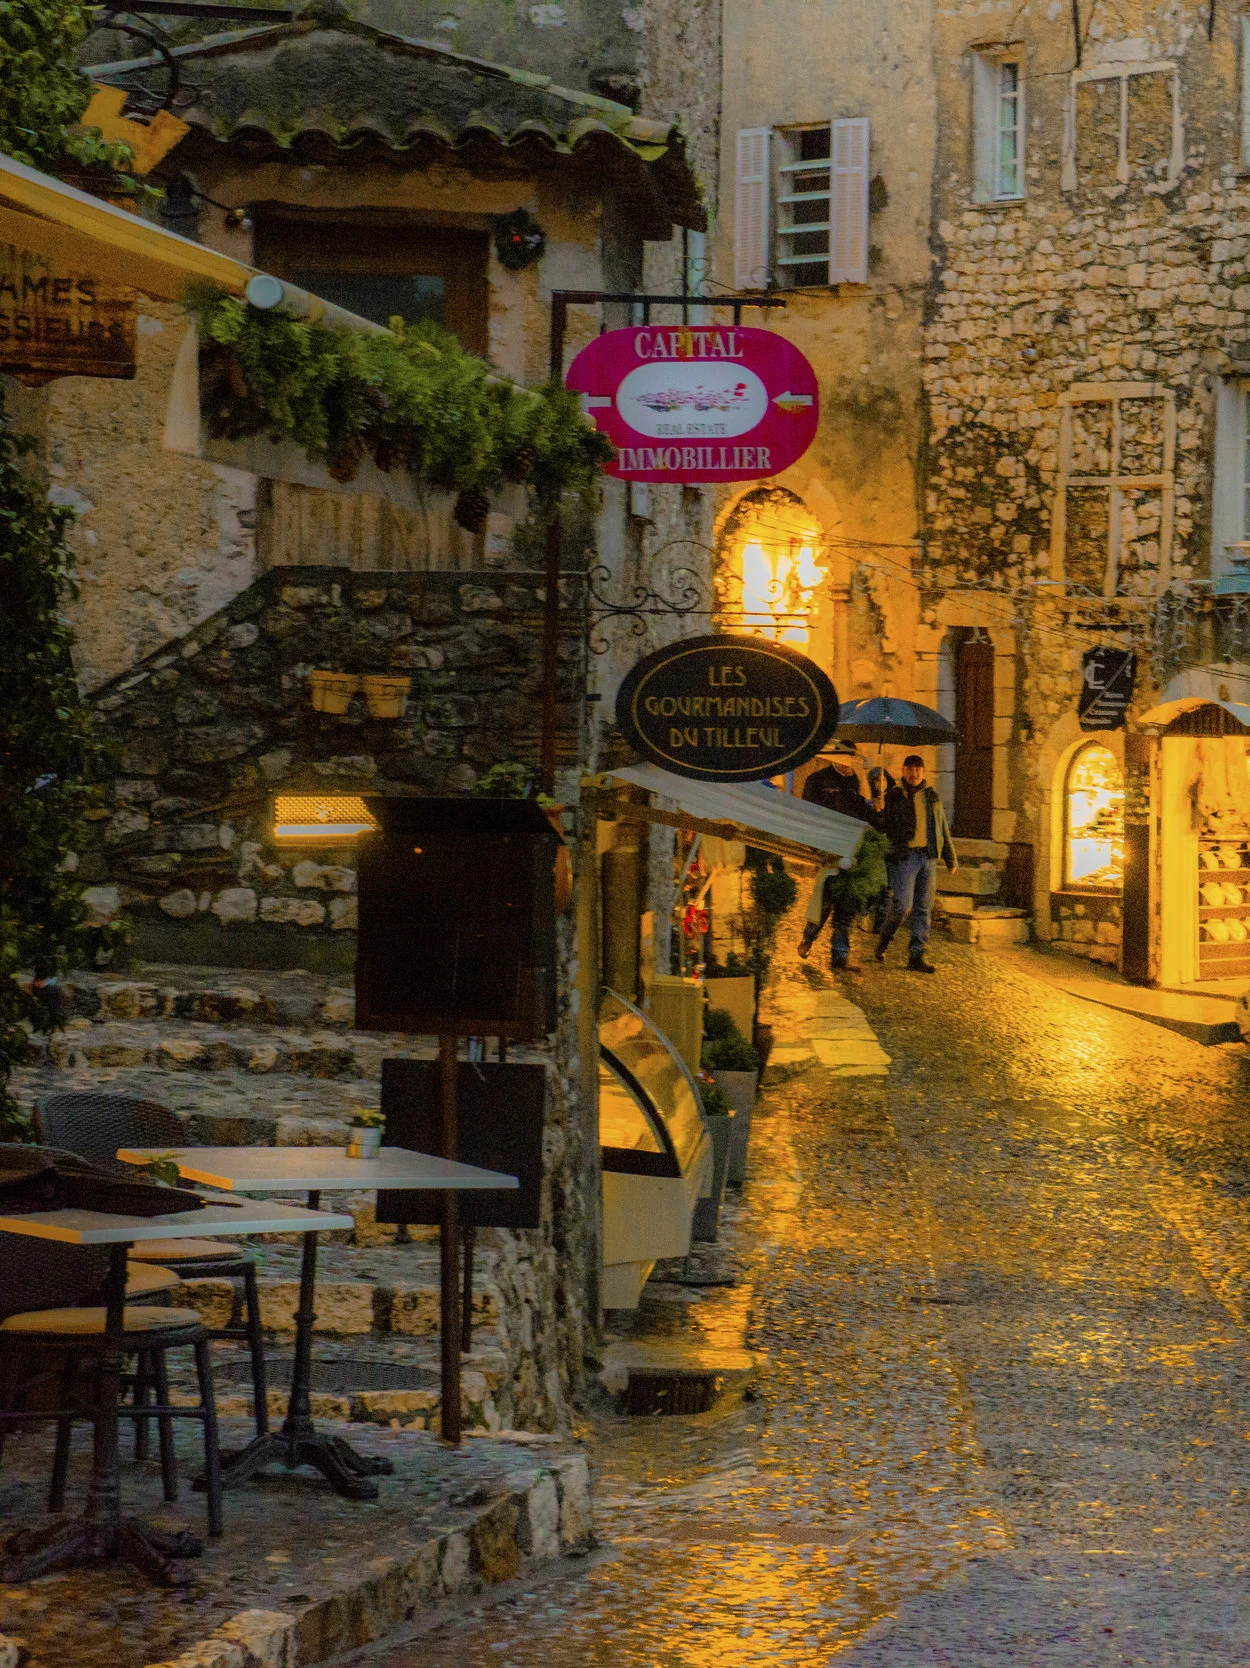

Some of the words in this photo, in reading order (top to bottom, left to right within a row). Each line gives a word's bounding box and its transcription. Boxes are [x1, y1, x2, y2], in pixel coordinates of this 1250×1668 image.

[634, 332, 744, 358] CAPITAL
[656, 423, 685, 435] REAL
[687, 423, 727, 435] ESTATE
[618, 447, 772, 471] IMMOBILLIER
[708, 666, 747, 687] LES
[644, 696, 811, 718] GOURMANDISES
[670, 727, 699, 748] DU
[703, 727, 786, 748] TILLEUL
